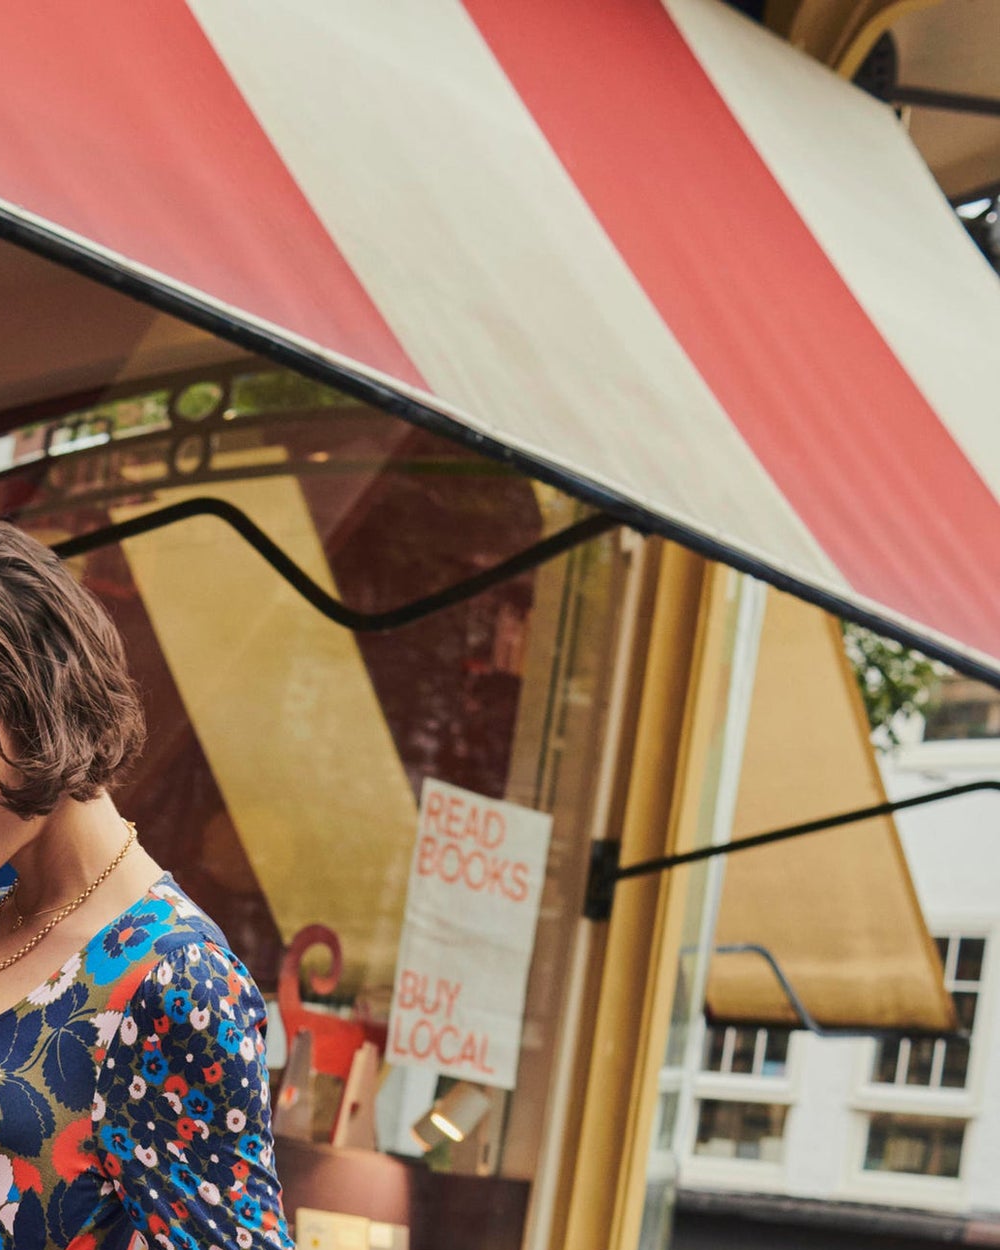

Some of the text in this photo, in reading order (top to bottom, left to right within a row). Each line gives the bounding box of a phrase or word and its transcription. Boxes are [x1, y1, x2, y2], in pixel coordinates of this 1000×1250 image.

[424, 791, 506, 850] READ
[416, 835, 529, 902] BOOKS
[397, 969, 462, 1020] BUY
[392, 1015, 495, 1074] LOCAL
